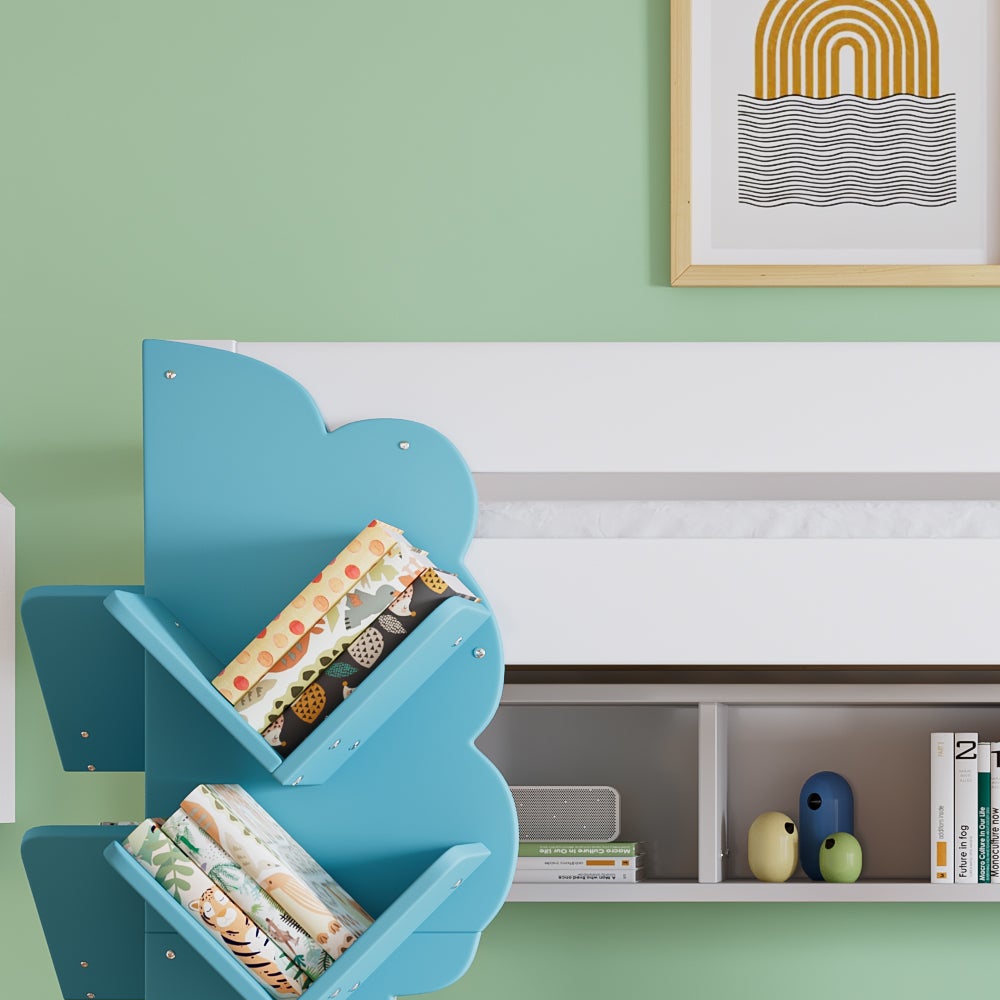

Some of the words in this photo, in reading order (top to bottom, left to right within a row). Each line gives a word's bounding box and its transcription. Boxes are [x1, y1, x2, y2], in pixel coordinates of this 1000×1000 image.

[956, 741, 977, 759] 2
[992, 807, 1000, 825] now
[959, 825, 970, 839] fog
[959, 840, 967, 849] in
[990, 826, 1000, 878] Monoculture
[959, 851, 967, 878] Future
